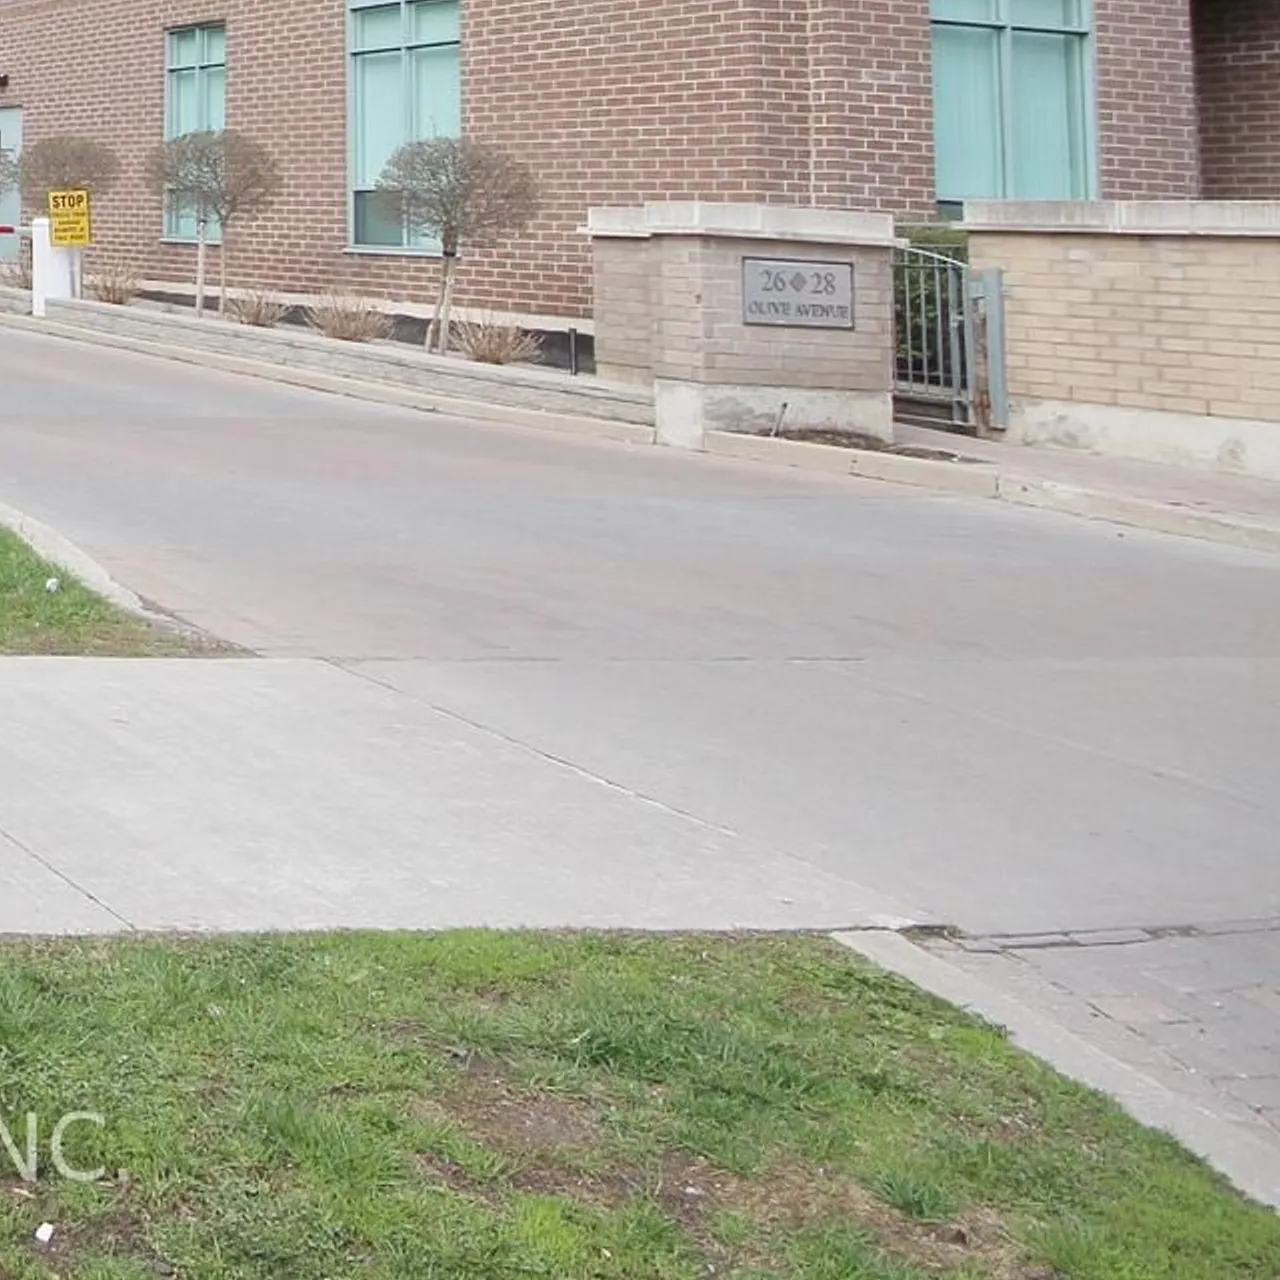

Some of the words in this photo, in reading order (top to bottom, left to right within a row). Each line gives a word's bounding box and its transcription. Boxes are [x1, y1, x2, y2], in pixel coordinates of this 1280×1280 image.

[52, 194, 85, 209] STOP
[759, 269, 787, 292] 26
[808, 271, 837, 296] 28
[747, 300, 791, 316] OLIVE
[795, 303, 849, 320] AVENUE
